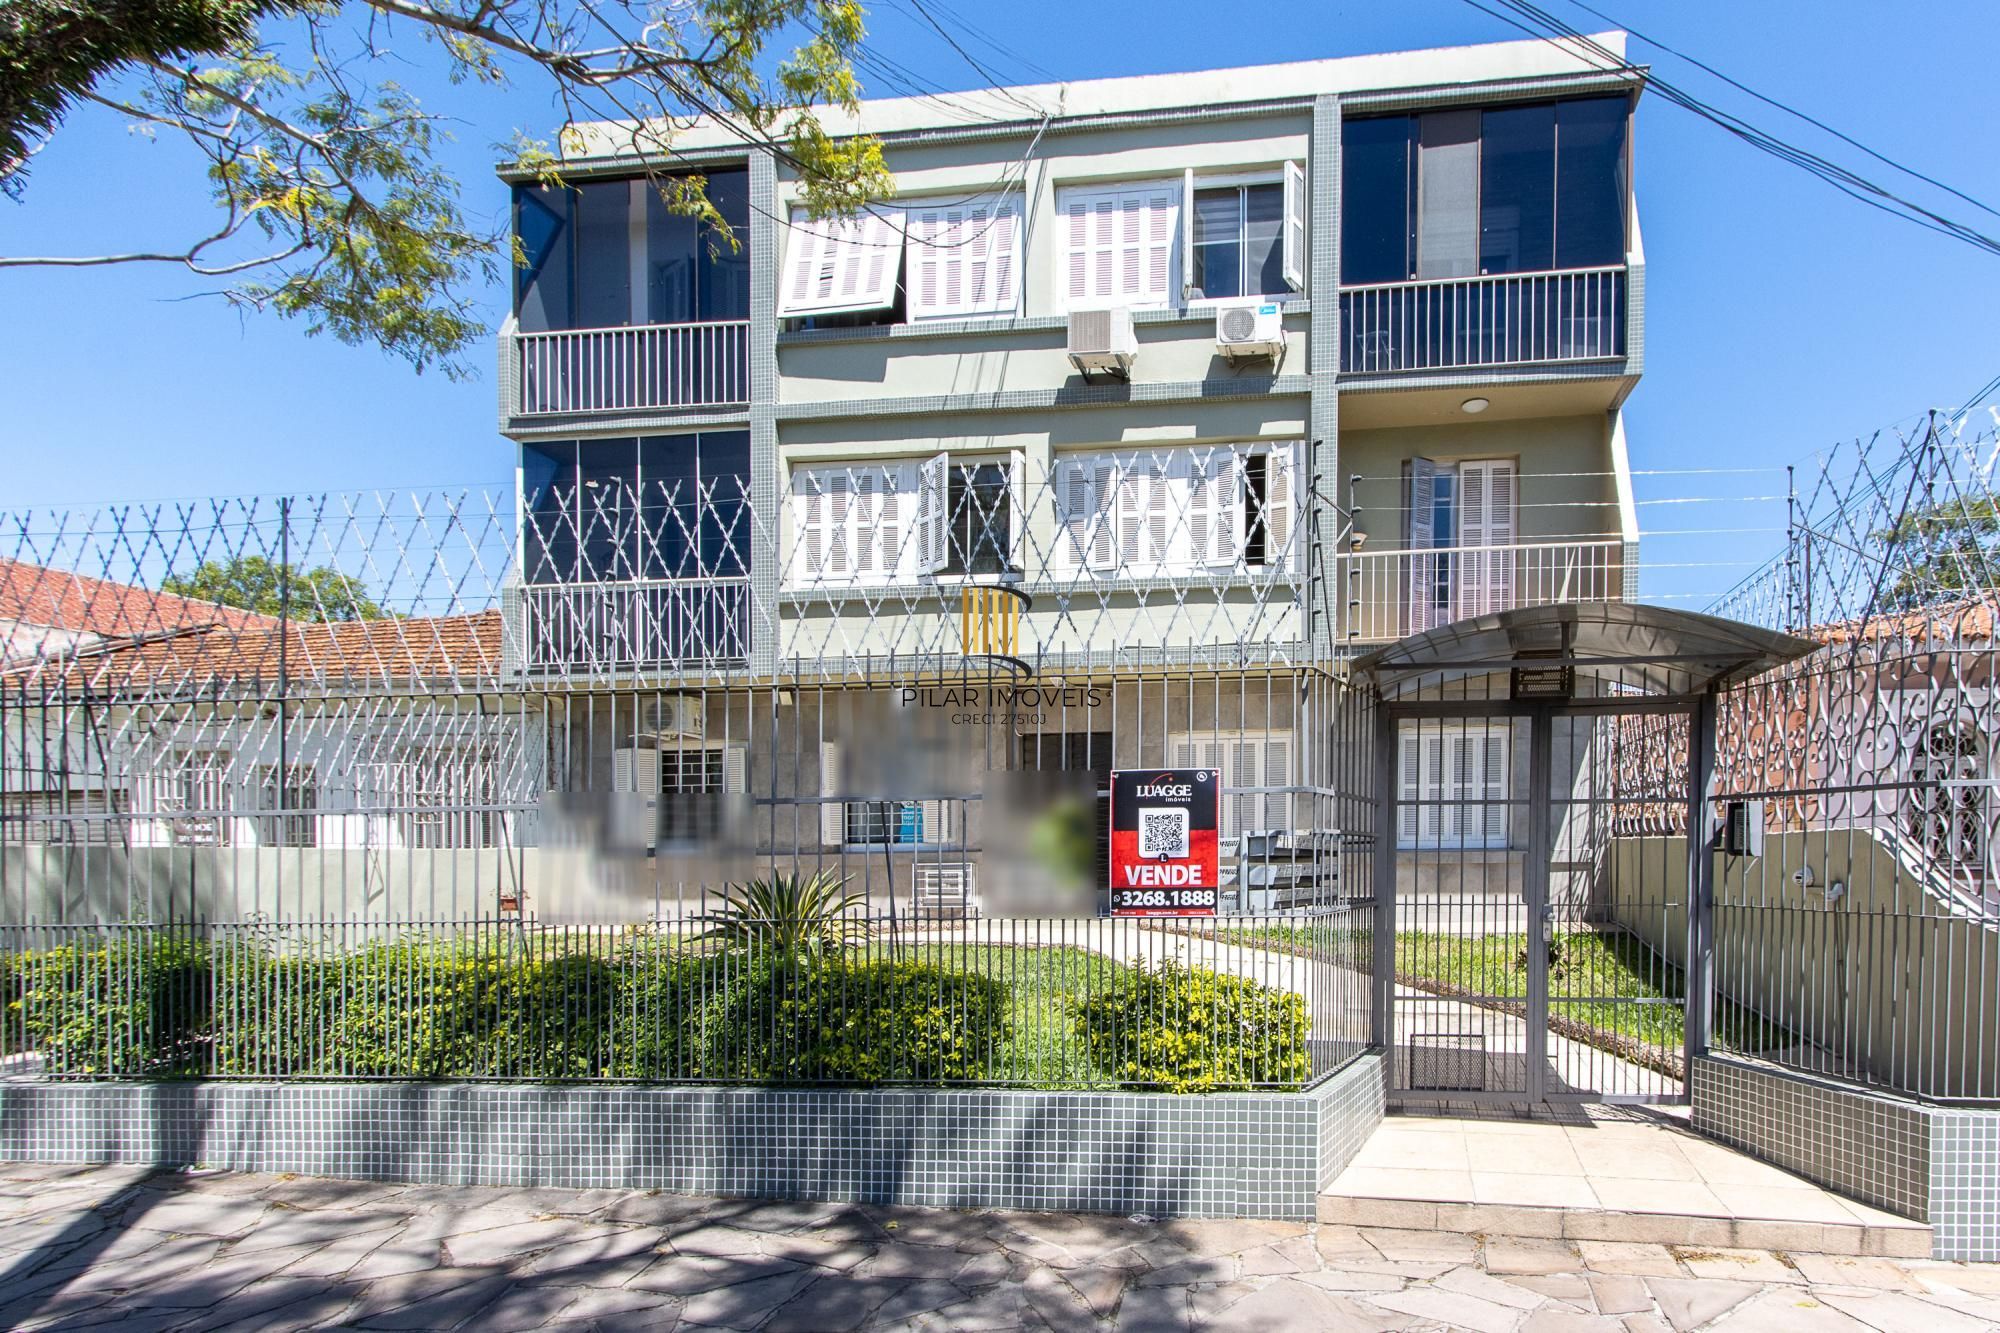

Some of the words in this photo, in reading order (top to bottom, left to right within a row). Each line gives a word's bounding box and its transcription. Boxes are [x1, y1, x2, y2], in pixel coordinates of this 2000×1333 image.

[1136, 785, 1192, 797] LUAGGE
[1124, 865, 1202, 885] VENDE
[1122, 890, 1215, 906] 3268.1888
